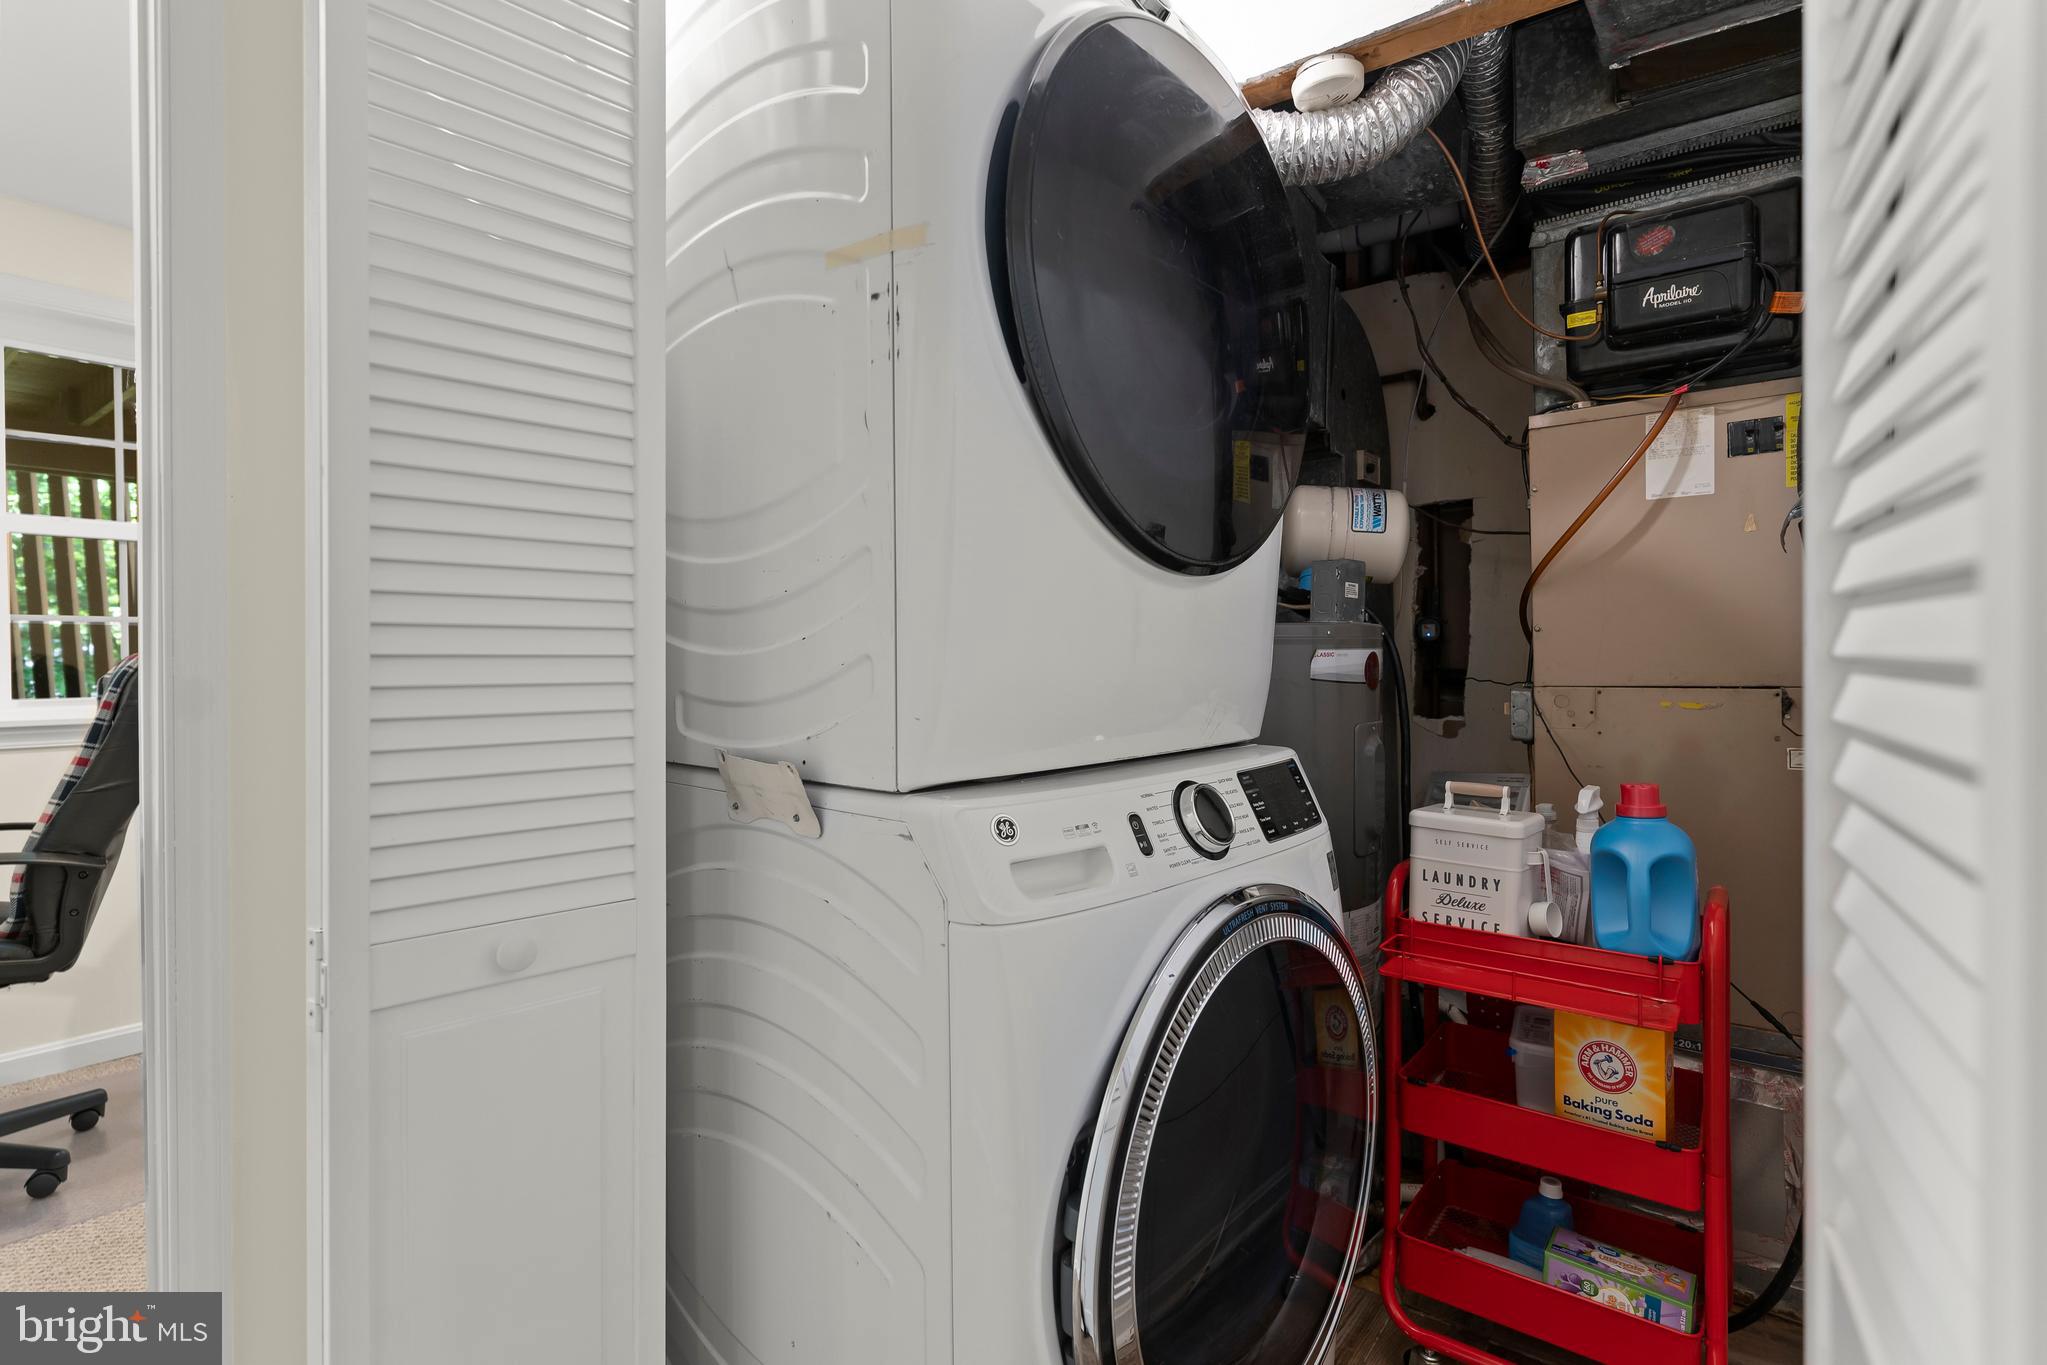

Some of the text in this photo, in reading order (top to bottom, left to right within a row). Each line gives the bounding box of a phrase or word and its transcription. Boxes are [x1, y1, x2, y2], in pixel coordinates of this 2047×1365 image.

[1642, 284, 1702, 308] Aprilaire
[1372, 493, 1382, 517] WATTS
[1457, 840, 1488, 851] SERVICE
[1422, 868, 1501, 892] LAUNDRY
[1270, 901, 1289, 911] SYSTEM
[1435, 893, 1486, 911] Deluxe
[1422, 911, 1501, 933] SERVICE
[1581, 1043, 1634, 1078] ARM & HAMMER
[1563, 1094, 1654, 1128] Baking Soda
[1594, 1096, 1619, 1108] pure
